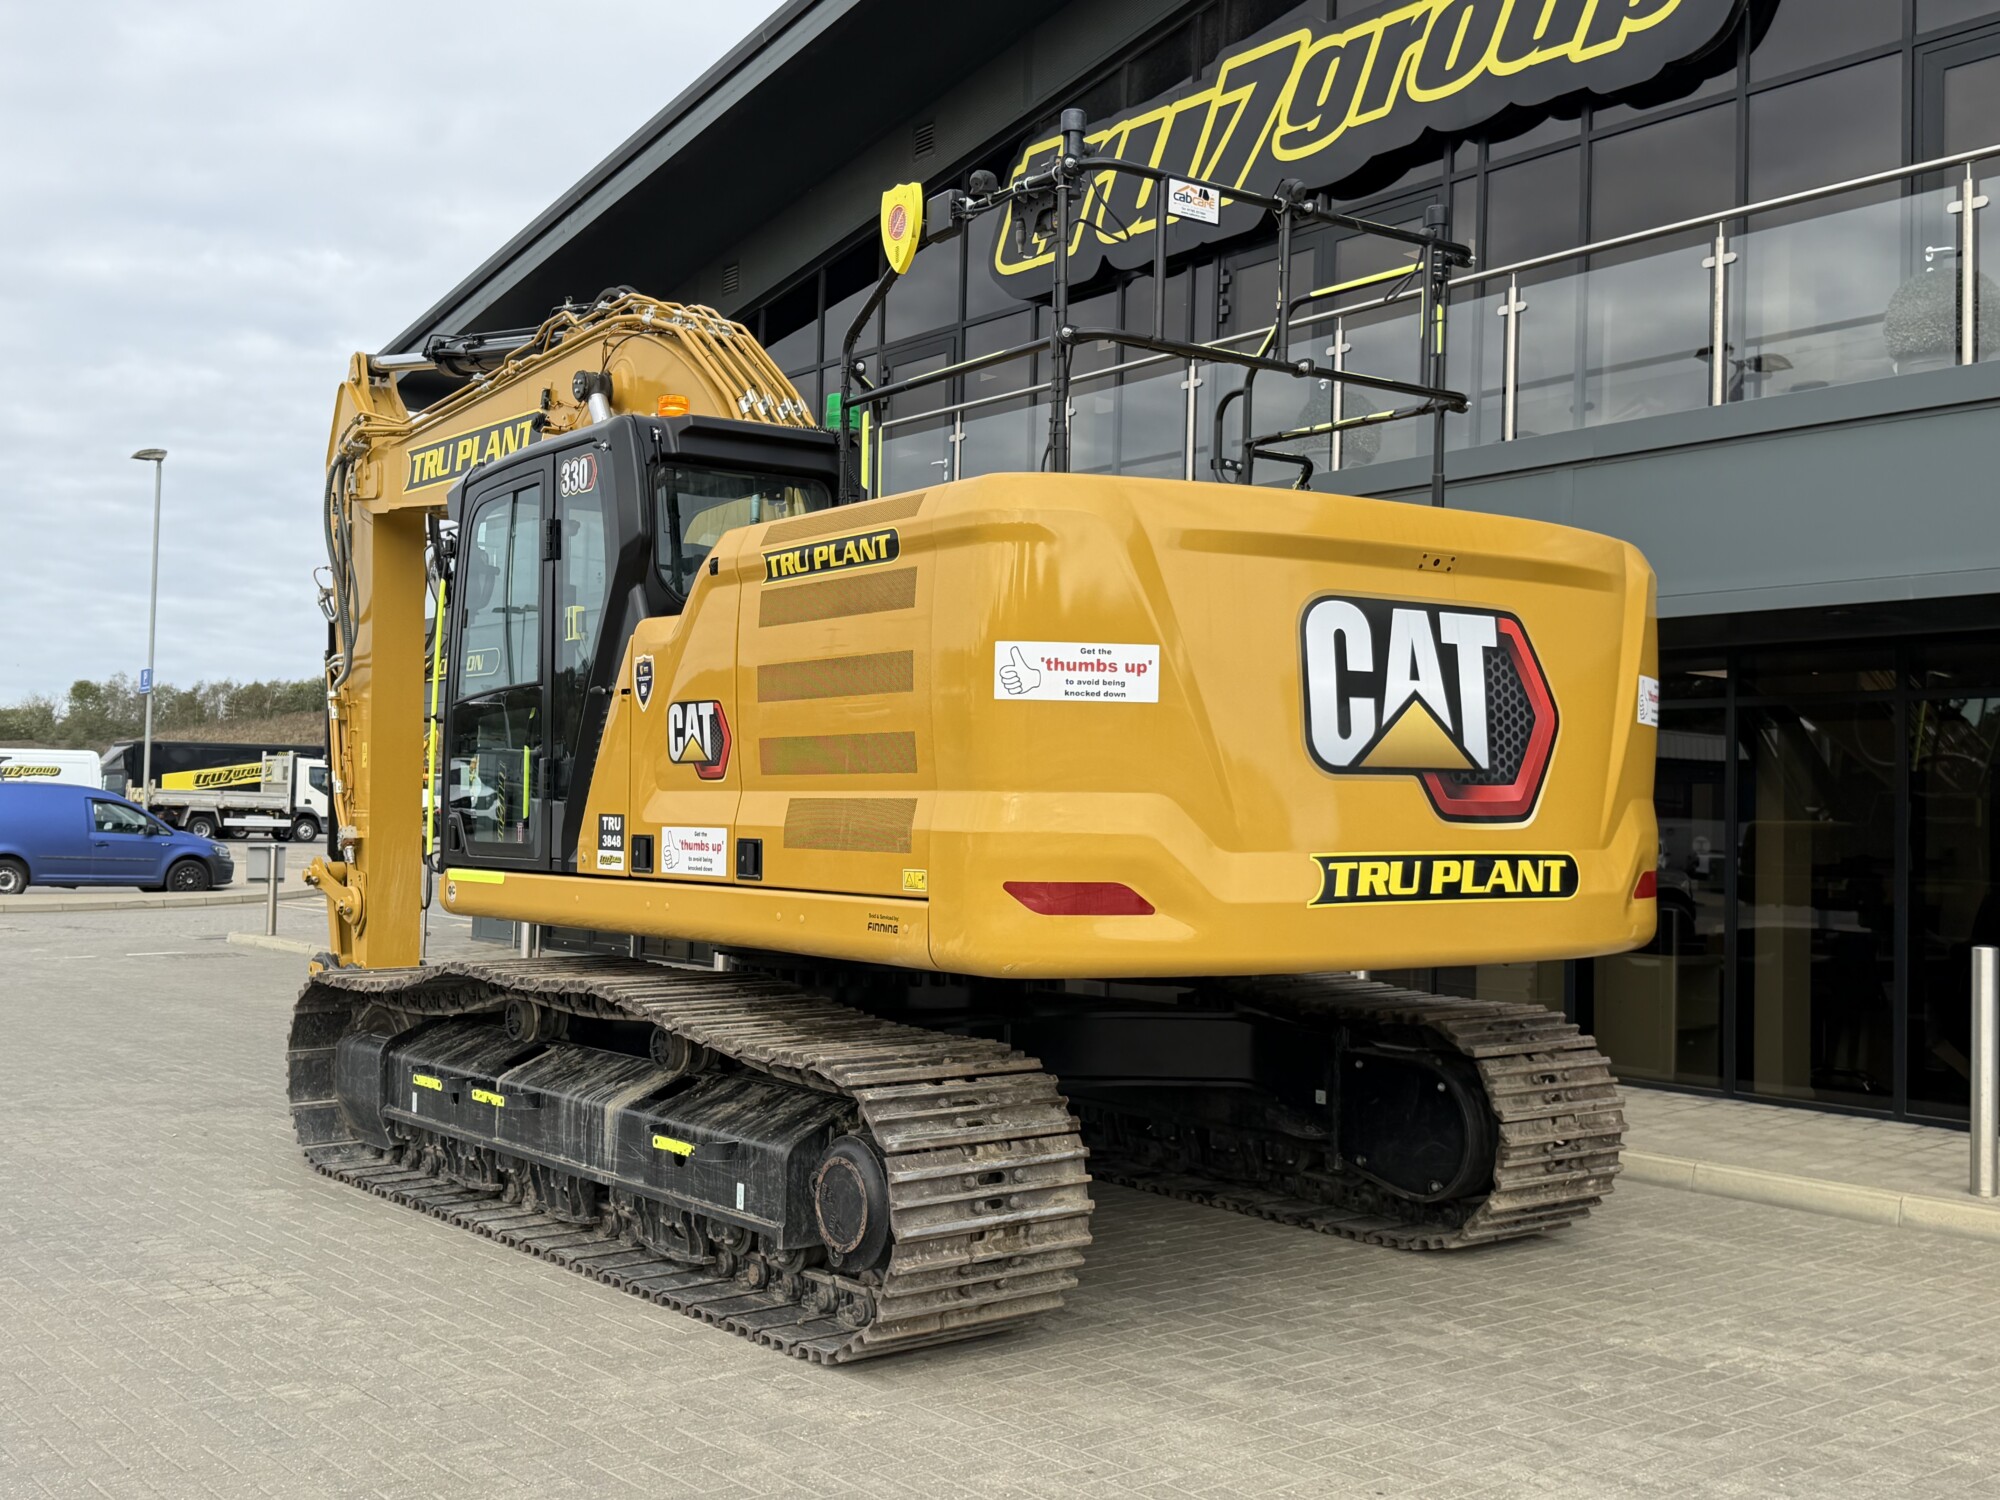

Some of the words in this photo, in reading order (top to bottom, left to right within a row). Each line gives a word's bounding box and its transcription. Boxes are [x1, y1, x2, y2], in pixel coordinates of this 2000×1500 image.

[412, 443, 454, 484] TRU
[454, 420, 533, 473] PLANT
[561, 457, 588, 495] 330
[767, 548, 810, 578] TRU
[813, 533, 891, 571] PLANT
[1080, 647, 1096, 655] Get
[1098, 648, 1113, 656] the
[1040, 656, 1118, 674] 'thumbs
[1125, 659, 1153, 677] up'
[1065, 678, 1074, 686] to
[1076, 678, 1100, 686] avoid
[1102, 679, 1126, 688] being
[1305, 600, 1498, 770] CAT
[1064, 690, 1101, 698] knocked
[1103, 690, 1127, 698] down
[668, 702, 714, 762] CAT
[602, 816, 621, 831] TRU
[602, 834, 622, 848] 3848
[679, 839, 710, 852] 'thumbs
[712, 840, 724, 855] up'
[1327, 860, 1422, 897] TRU
[1429, 859, 1567, 895] PLANT
[867, 922, 898, 934] FINNING
